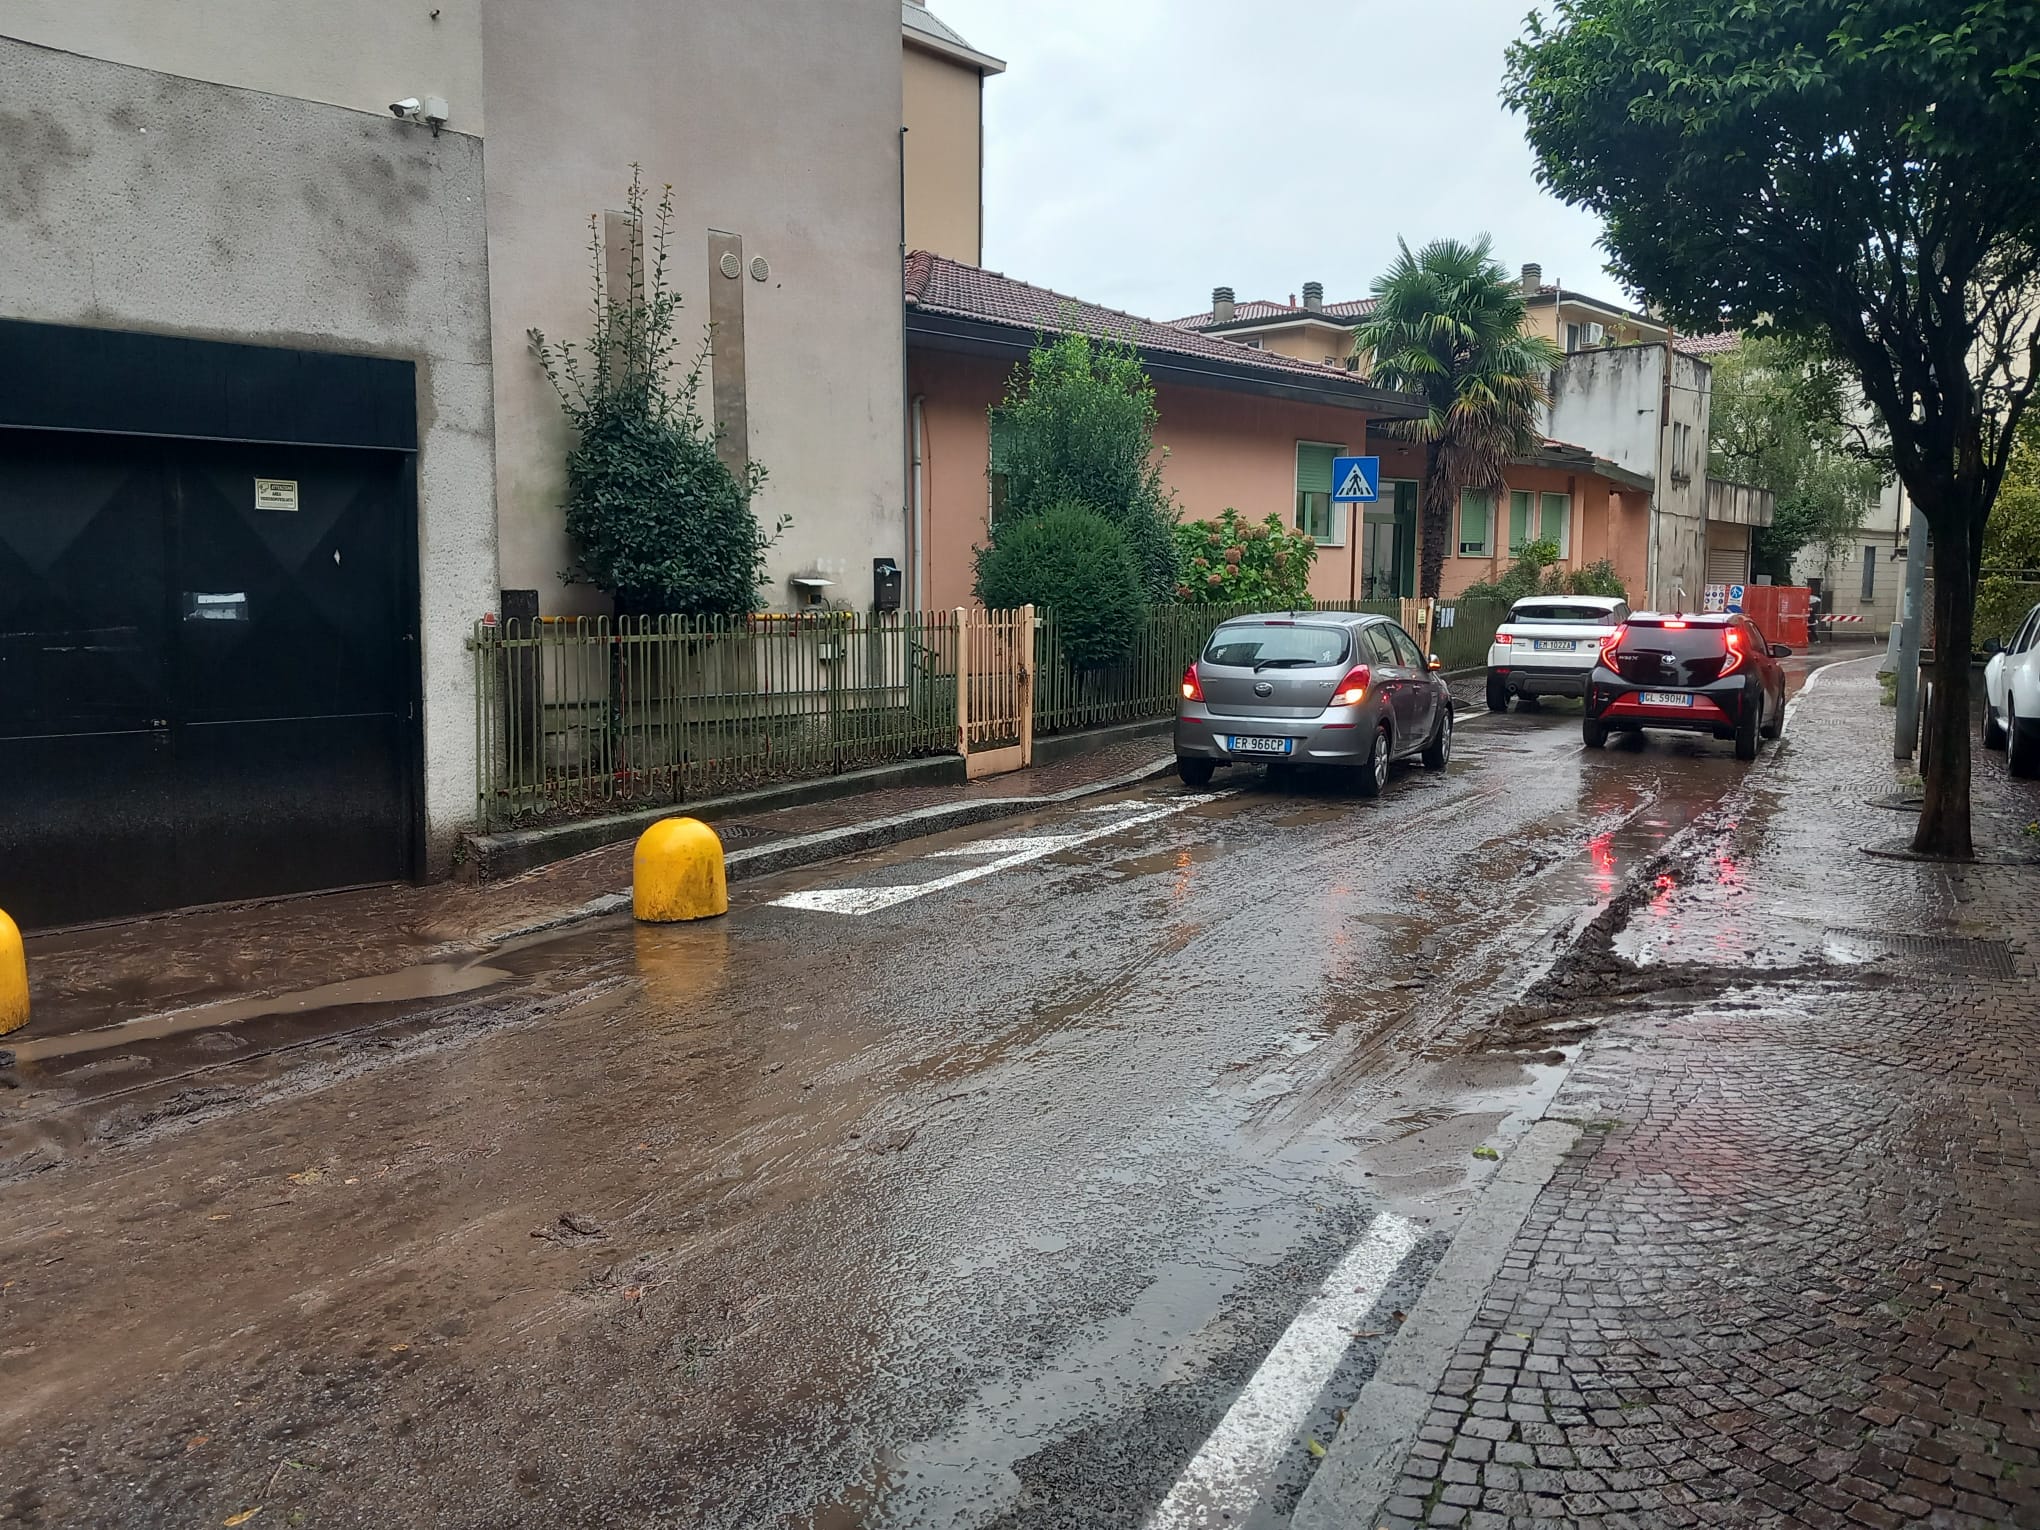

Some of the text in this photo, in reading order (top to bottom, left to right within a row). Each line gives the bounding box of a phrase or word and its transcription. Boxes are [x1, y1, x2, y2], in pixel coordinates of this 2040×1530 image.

[1659, 693, 1686, 704] 590HA
[1235, 737, 1283, 751] ER 966CP
